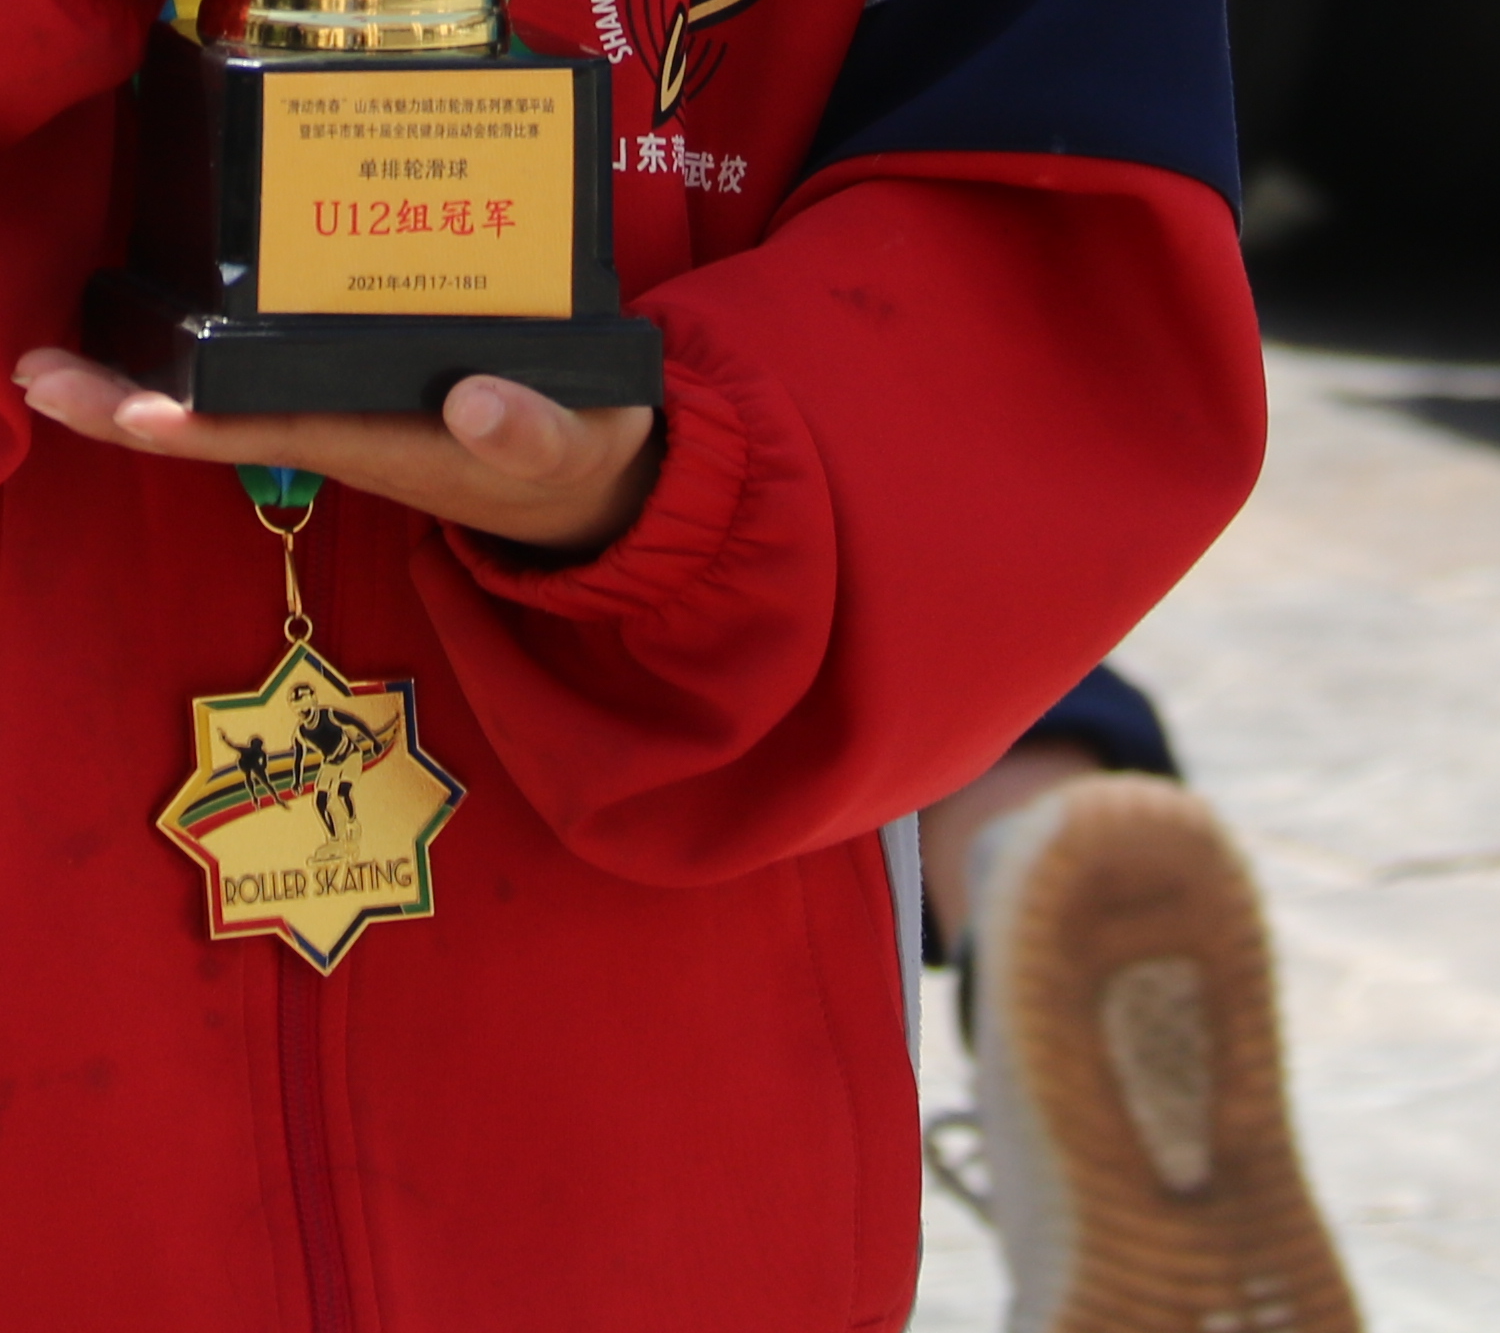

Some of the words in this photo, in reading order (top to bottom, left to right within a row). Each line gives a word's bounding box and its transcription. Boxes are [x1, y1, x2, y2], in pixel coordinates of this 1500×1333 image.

[359, 158, 469, 181] 单排轮滑球
[313, 198, 517, 239] U12组冠军
[347, 274, 488, 291] 2021年4月17-18日
[224, 869, 307, 906] ROLLER
[314, 857, 412, 896] SKATING
